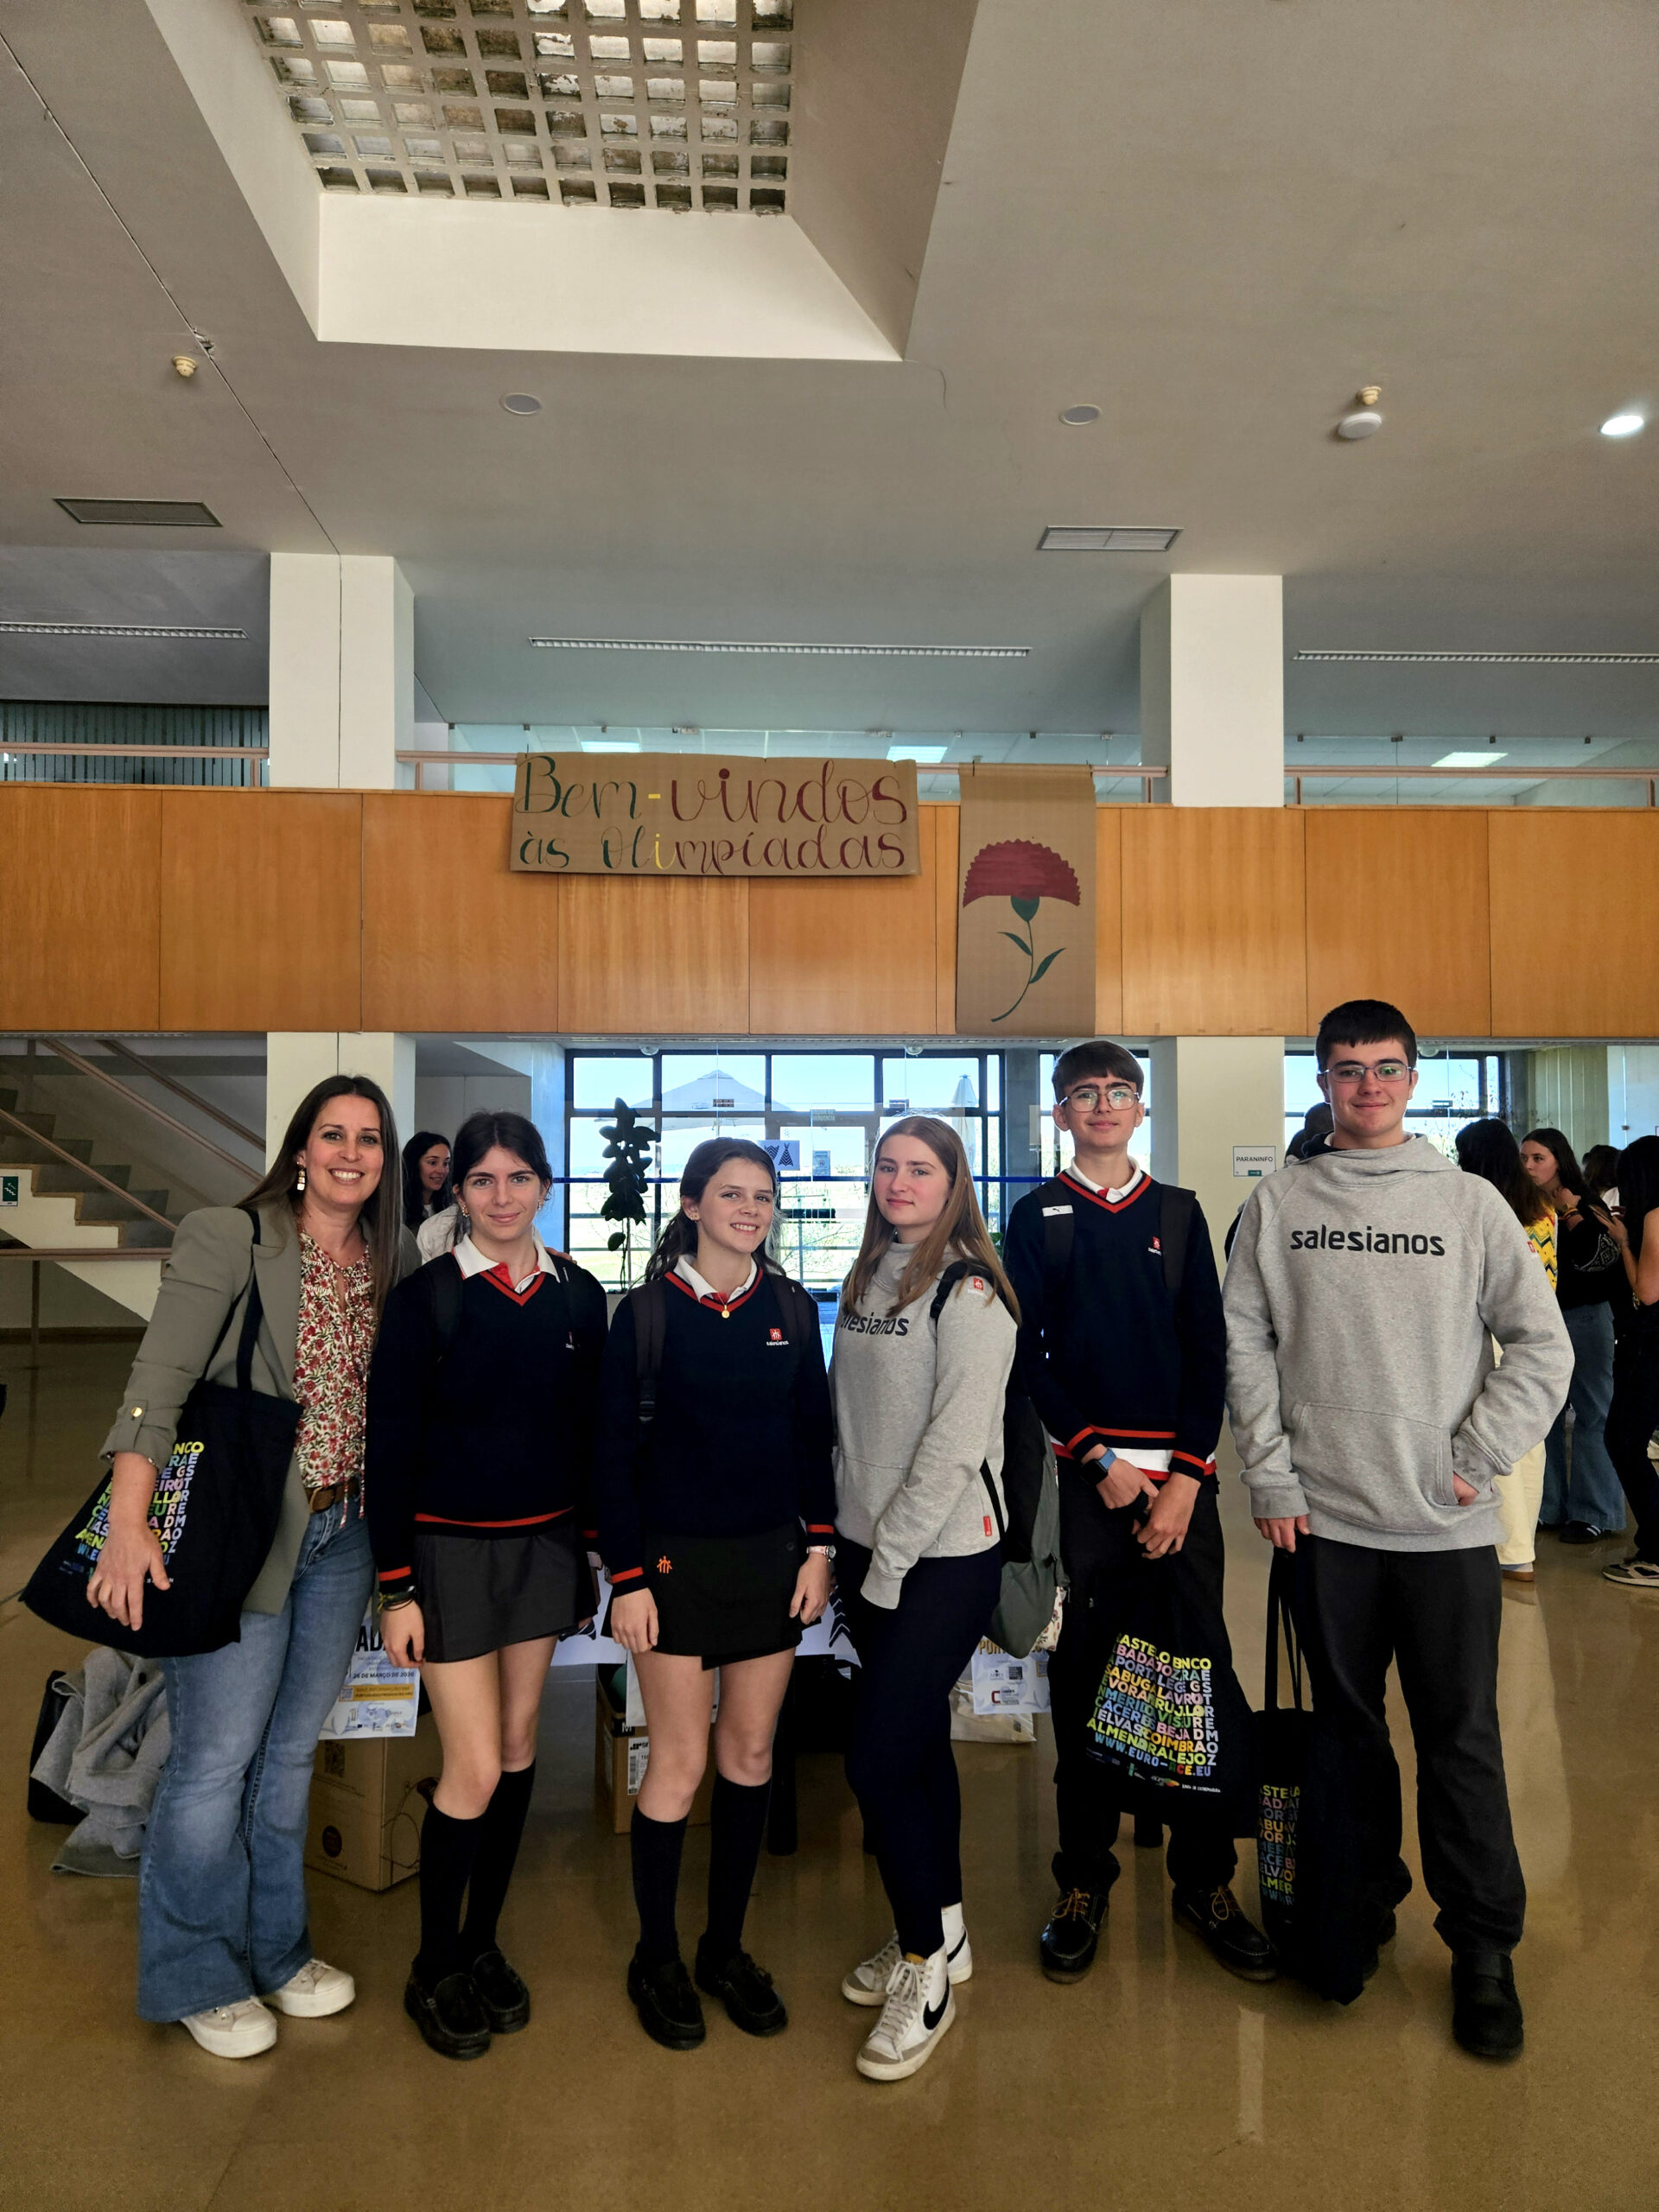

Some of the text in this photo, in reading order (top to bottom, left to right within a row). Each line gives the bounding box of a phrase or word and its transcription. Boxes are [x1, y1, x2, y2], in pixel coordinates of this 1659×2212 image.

[515, 755, 907, 824] Bem-vindos
[519, 823, 905, 874] às Olimpíadas
[1290, 1224, 1446, 1256] salesianos
[841, 1312, 910, 1336] lesianos
[356, 1625, 385, 1651] AD
